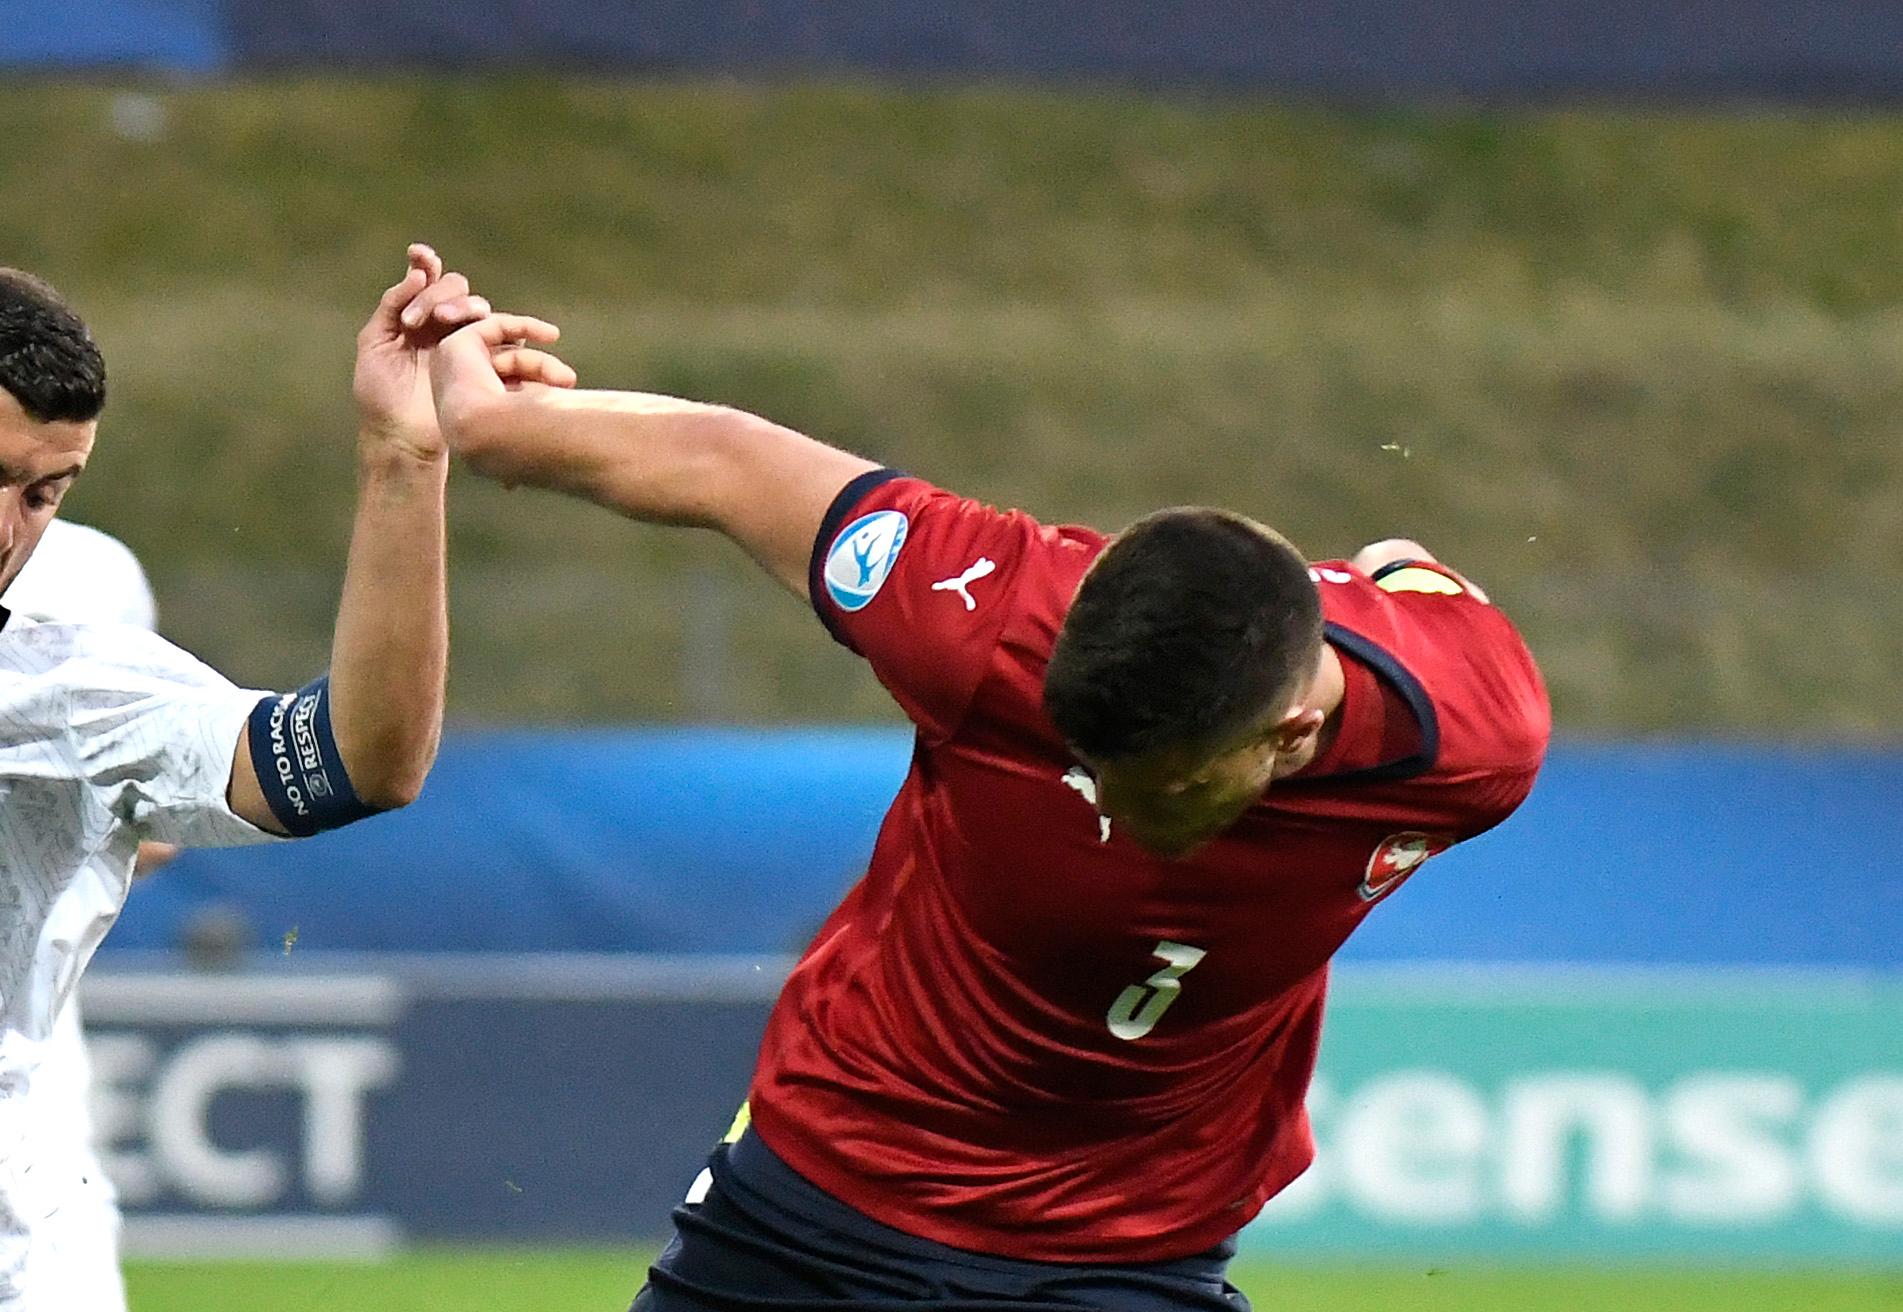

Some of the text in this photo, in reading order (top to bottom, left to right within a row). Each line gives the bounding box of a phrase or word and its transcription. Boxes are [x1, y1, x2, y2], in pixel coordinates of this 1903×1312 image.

[294, 694, 318, 770] RESPECT
[276, 756, 294, 786] TO
[286, 785, 309, 816] NO
[1106, 940, 1208, 1041] 3
